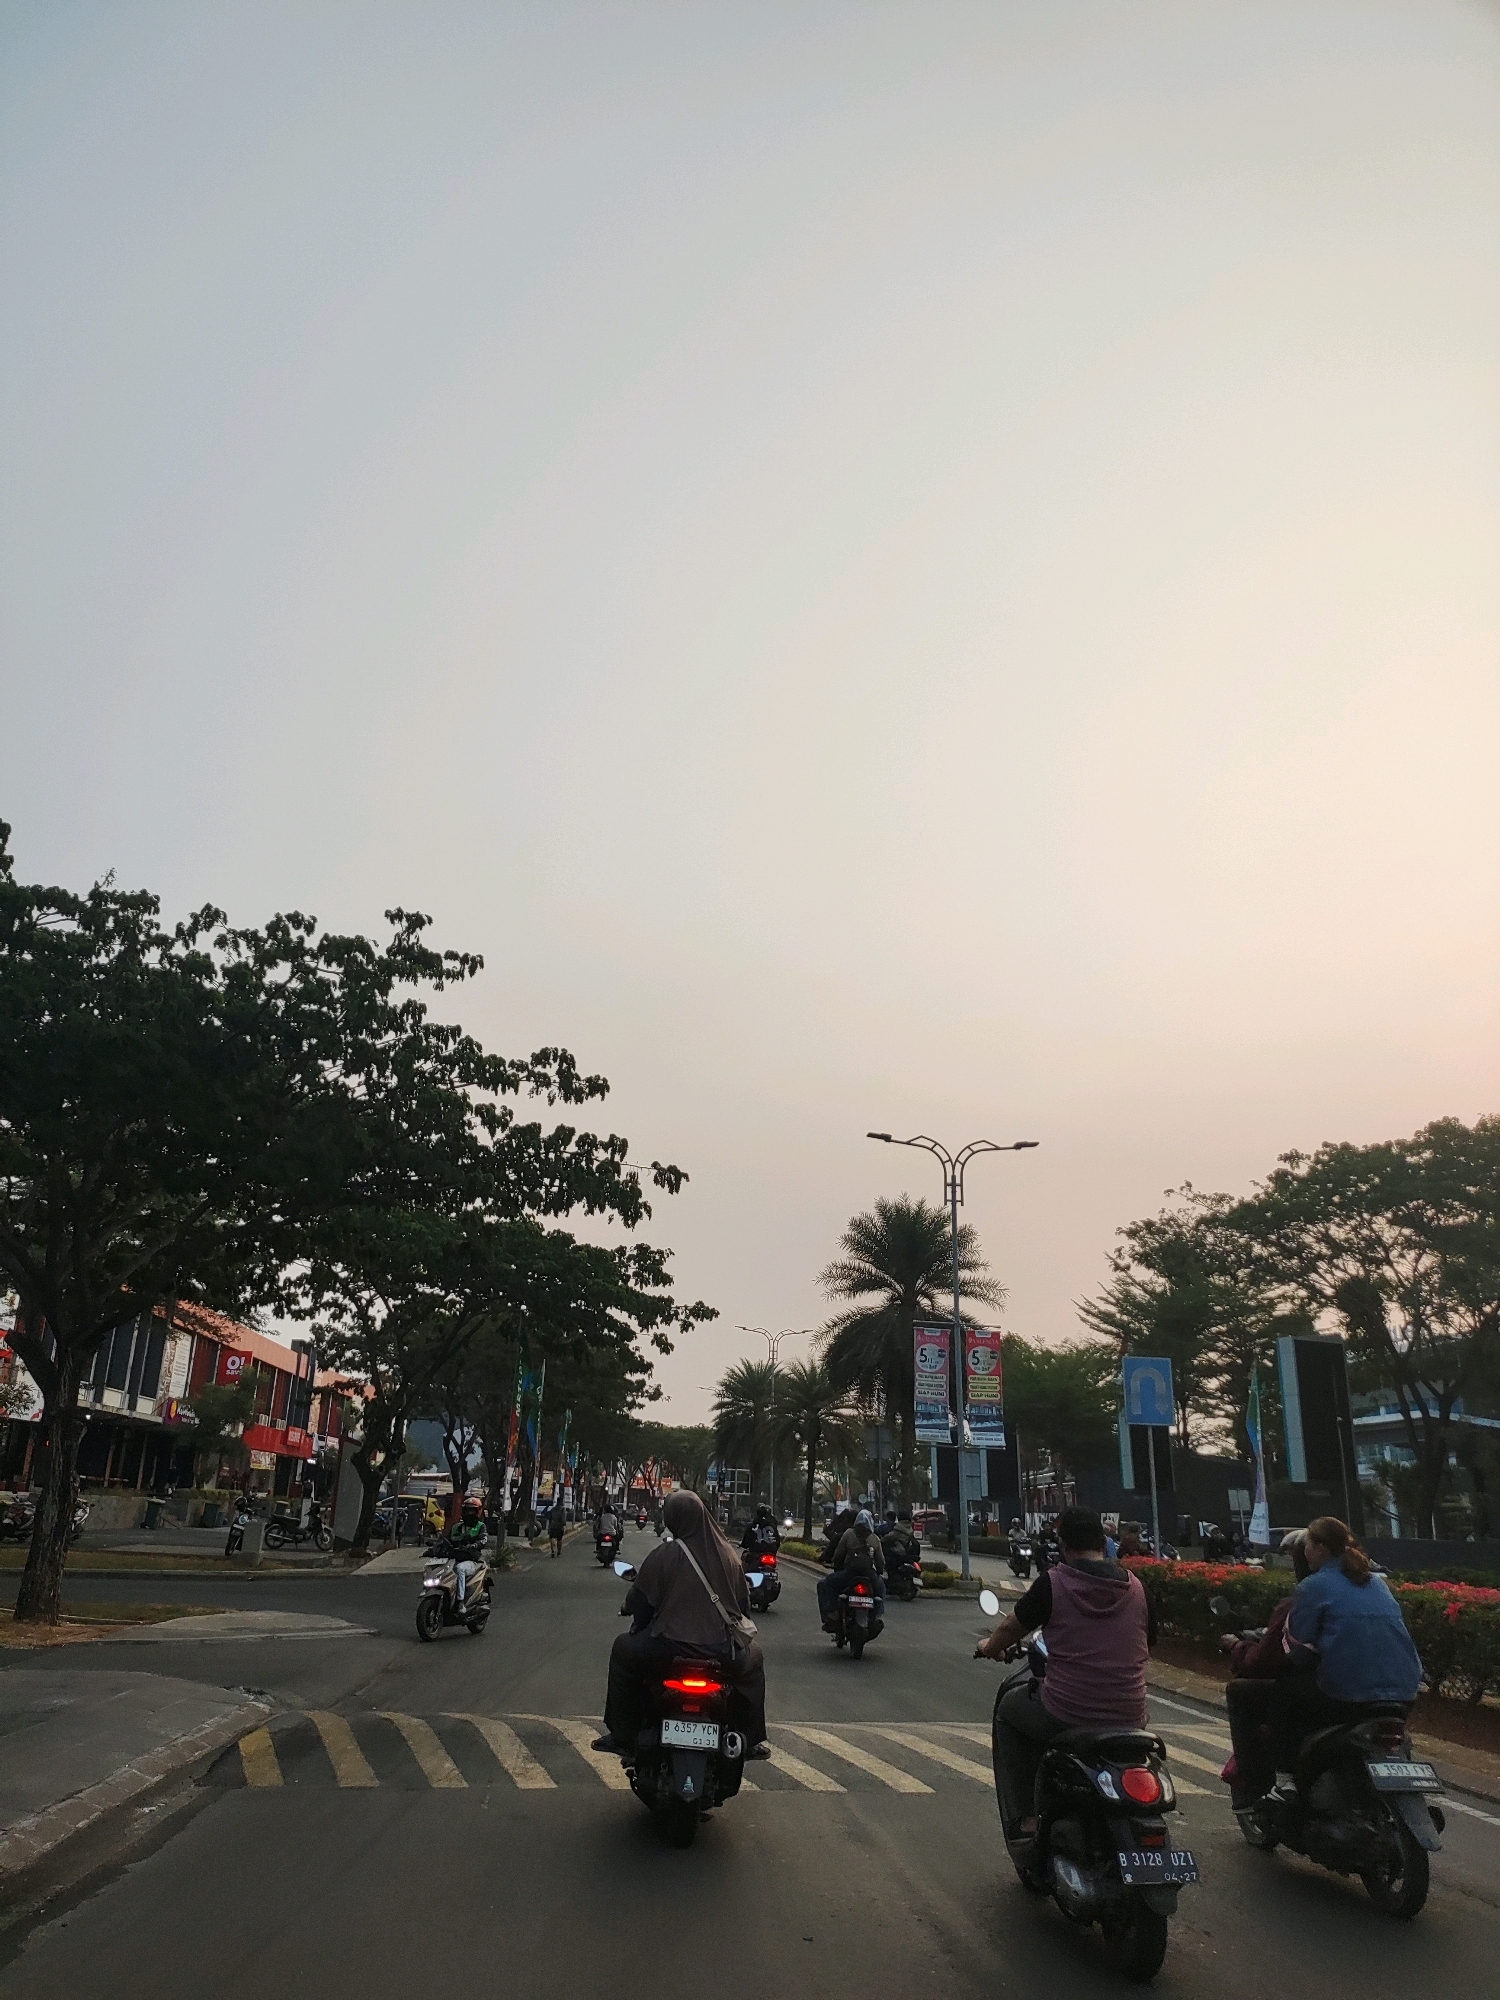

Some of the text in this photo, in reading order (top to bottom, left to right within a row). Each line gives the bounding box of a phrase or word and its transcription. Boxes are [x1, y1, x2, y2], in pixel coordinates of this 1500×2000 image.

[664, 1721, 718, 1735] B 6357 YCN
[1371, 1765, 1380, 1776] B
[1119, 1851, 1194, 1866] B 3128 UZI
